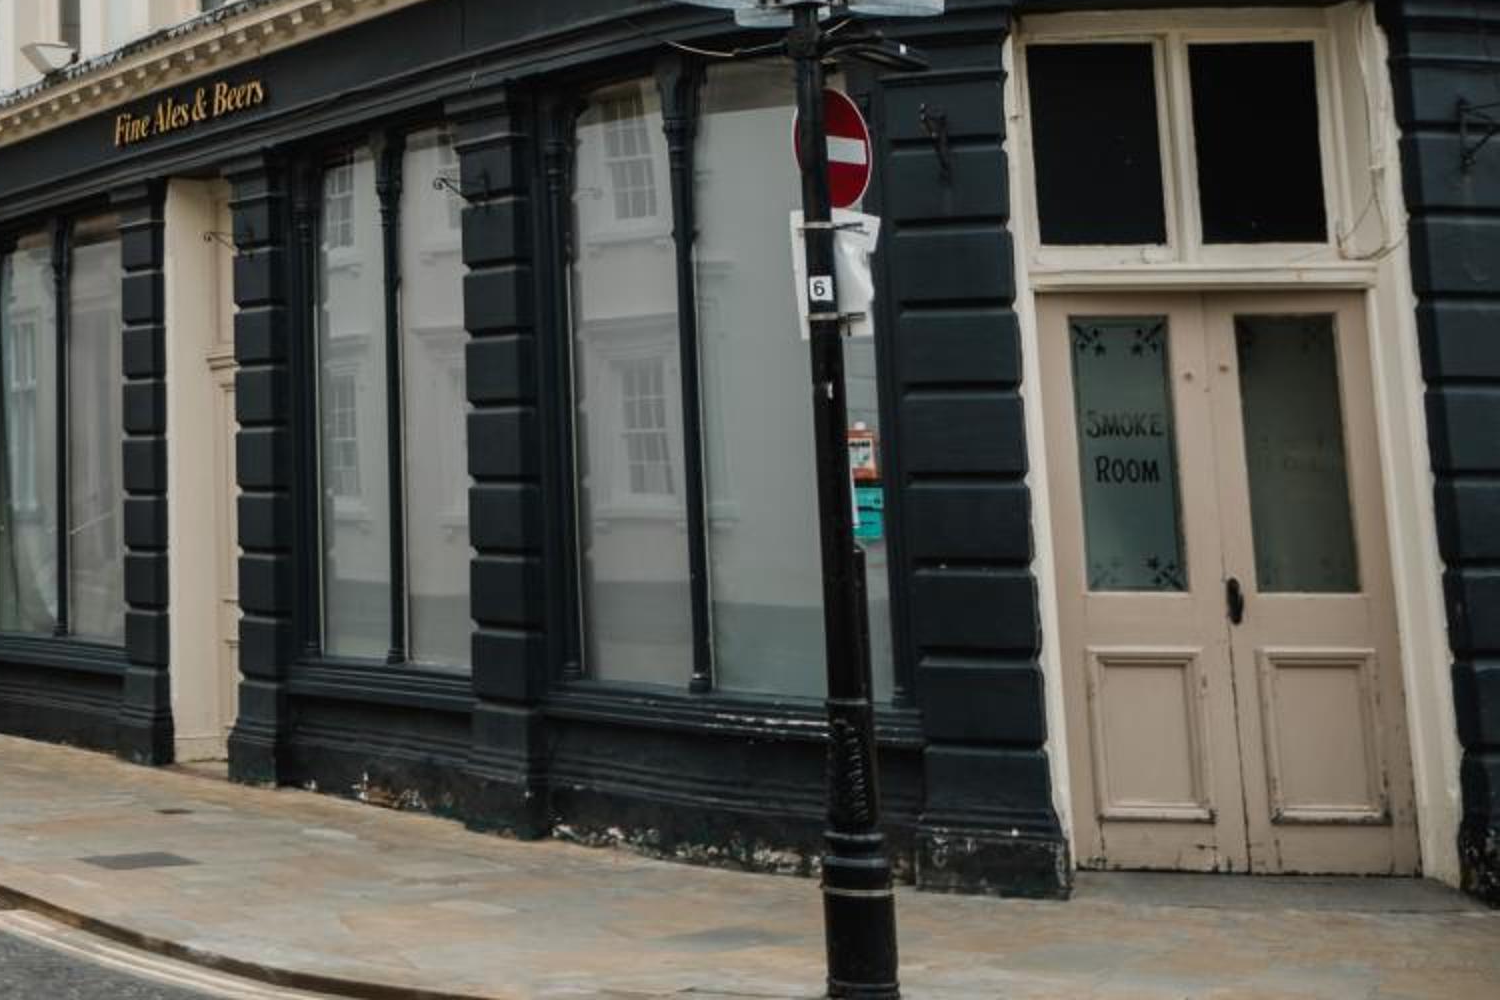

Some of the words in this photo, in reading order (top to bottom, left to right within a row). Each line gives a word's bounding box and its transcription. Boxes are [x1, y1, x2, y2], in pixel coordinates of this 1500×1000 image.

[115, 112, 150, 148] Fine
[151, 97, 190, 135] Ales
[191, 87, 208, 122] &
[213, 79, 265, 118] Beers
[813, 280, 826, 297] 6
[1086, 409, 1164, 439] SMOKE
[1094, 455, 1161, 483] ROOM
